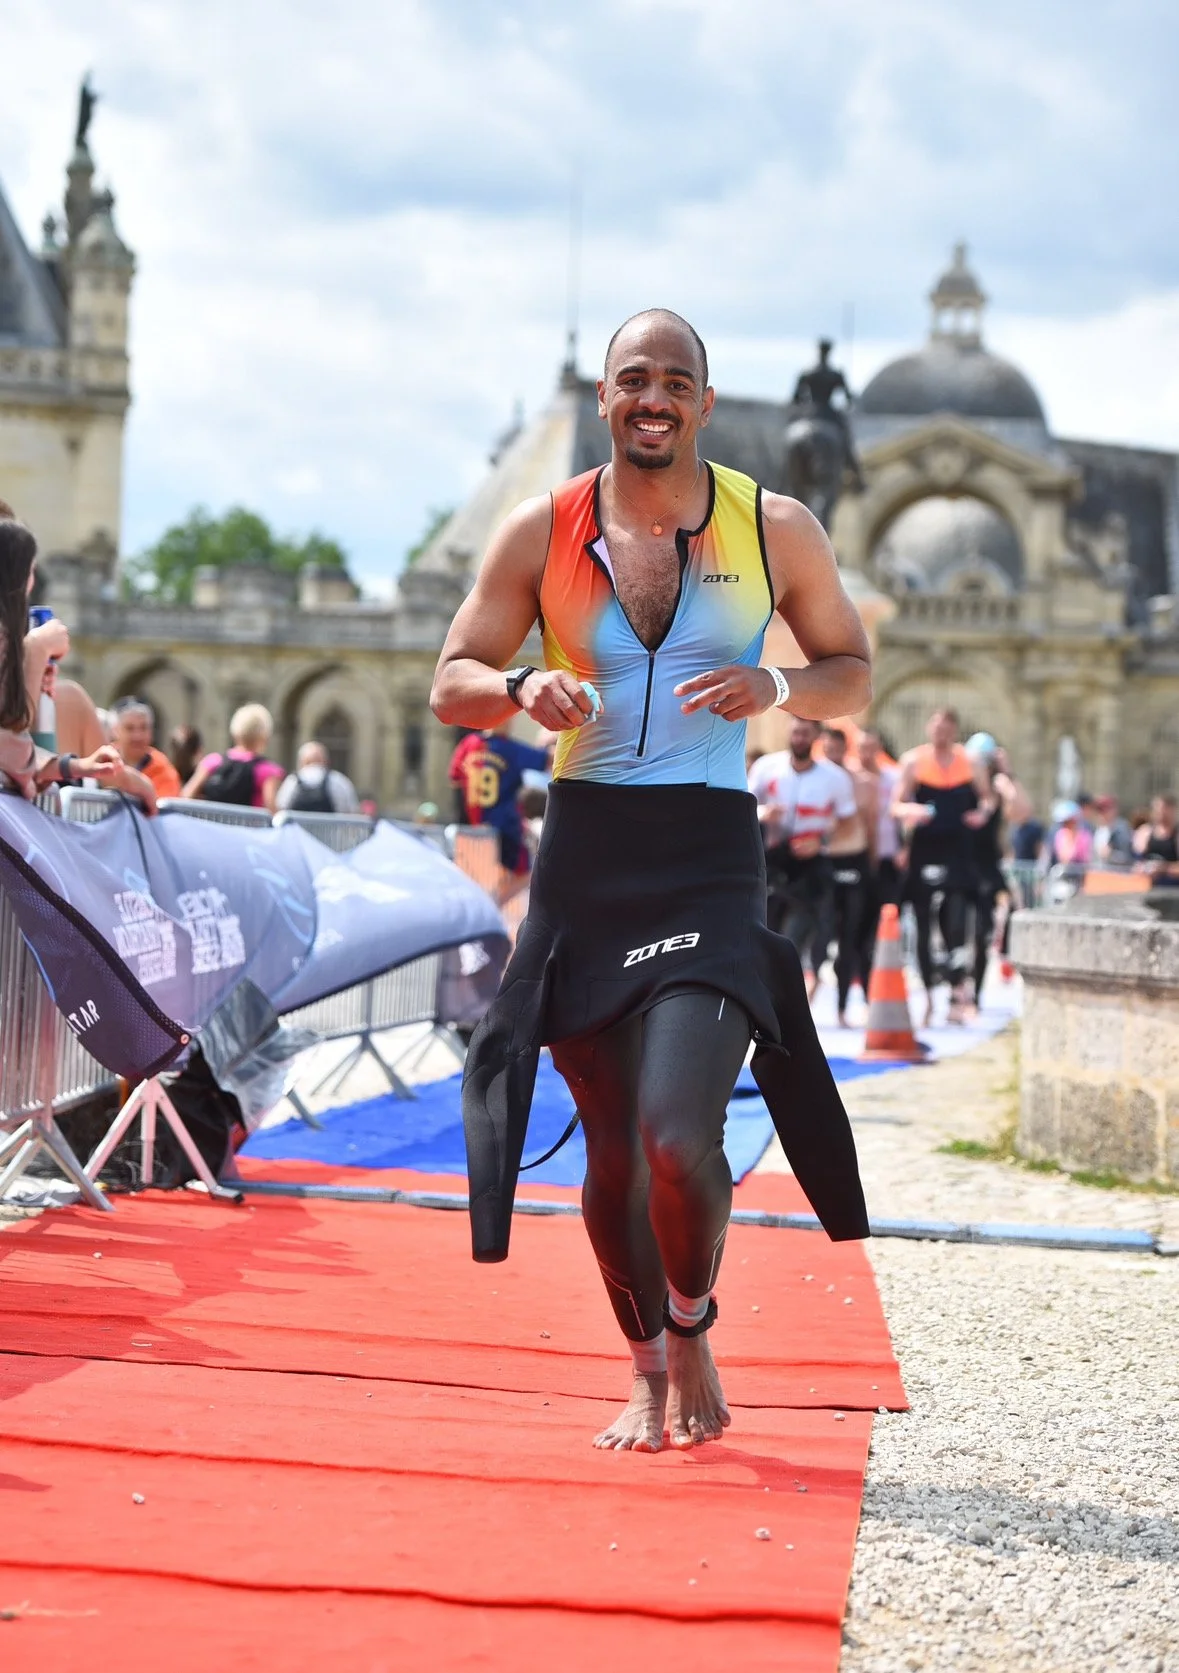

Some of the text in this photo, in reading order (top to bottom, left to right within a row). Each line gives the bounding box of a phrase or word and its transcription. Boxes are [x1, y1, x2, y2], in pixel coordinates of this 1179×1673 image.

[702, 574, 740, 583] ZONE3
[464, 765, 500, 808] 19
[623, 932, 701, 968] ZONE3
